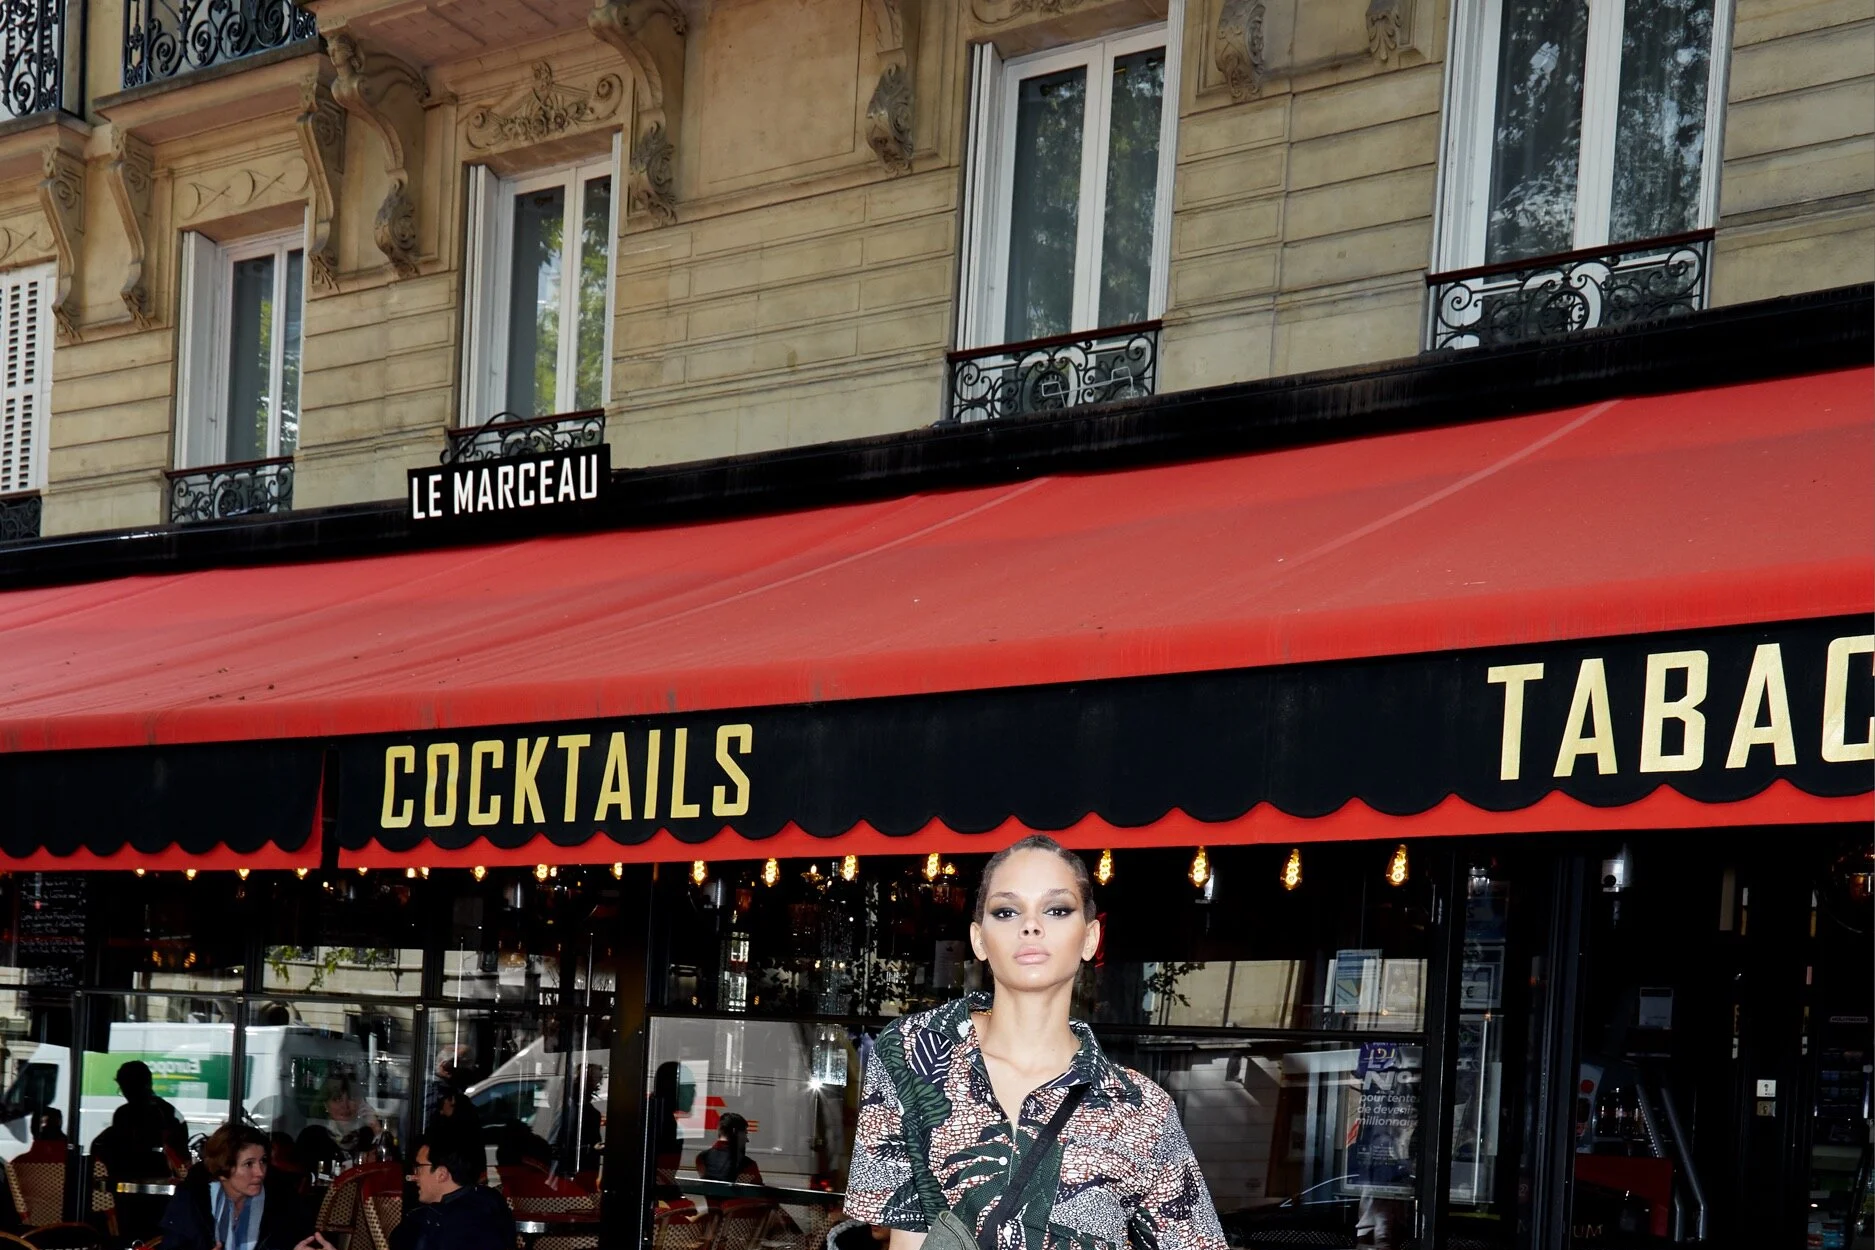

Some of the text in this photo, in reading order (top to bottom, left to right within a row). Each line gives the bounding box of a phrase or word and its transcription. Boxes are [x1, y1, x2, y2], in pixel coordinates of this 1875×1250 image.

[412, 454, 598, 519] LE MARCEAU
[1487, 634, 1875, 781] TABAC
[380, 723, 753, 829] COCKTAILS
[1357, 1103, 1371, 1114] de
[1359, 1094, 1386, 1104] pour
[1356, 1115, 1418, 1127] millionnai
